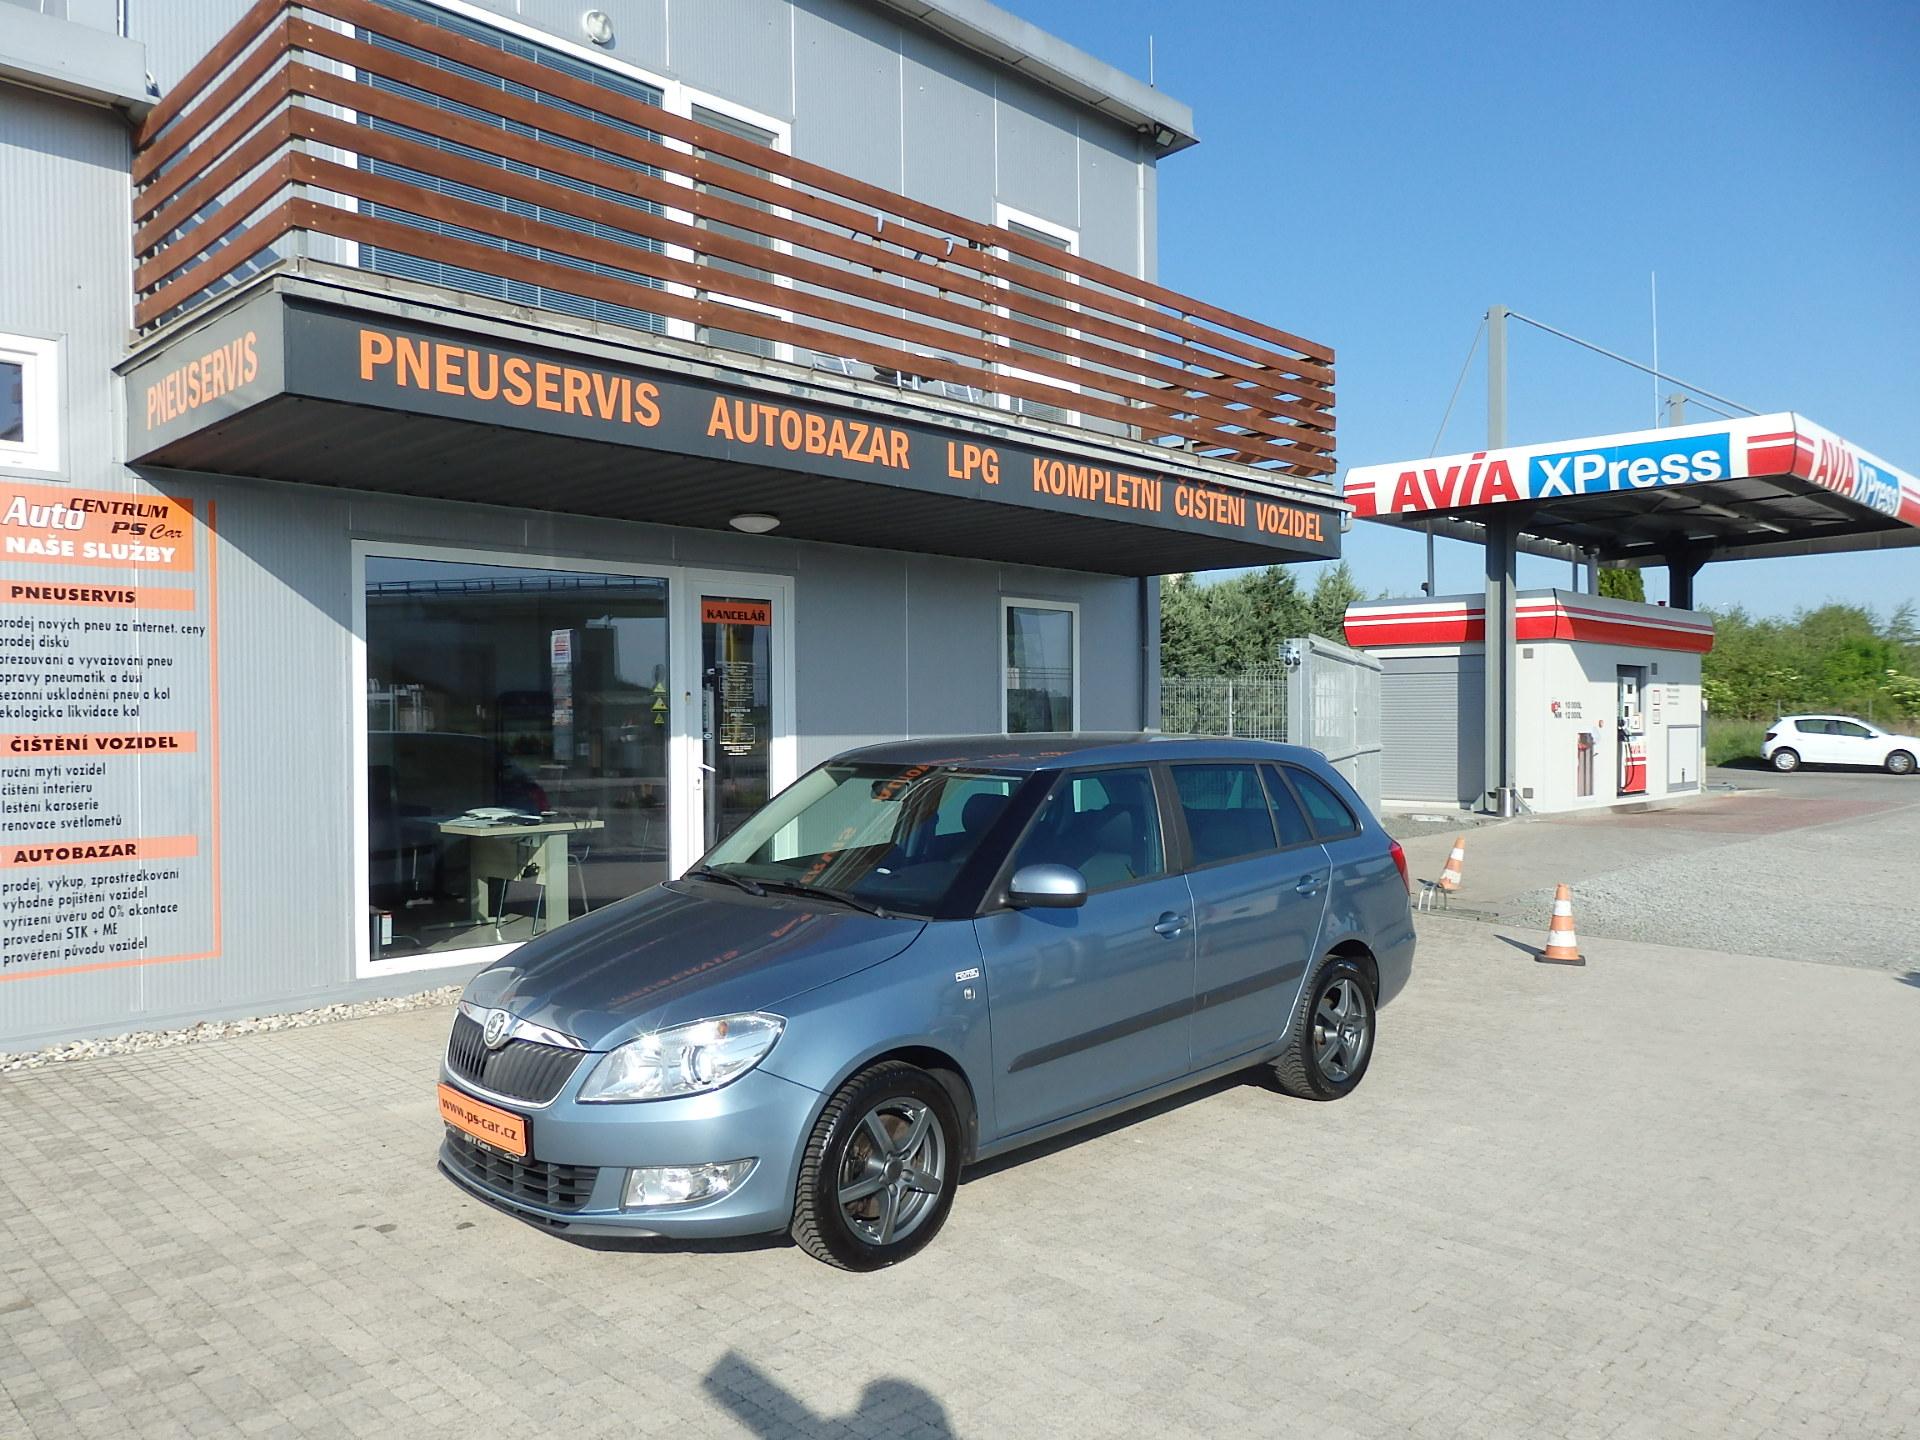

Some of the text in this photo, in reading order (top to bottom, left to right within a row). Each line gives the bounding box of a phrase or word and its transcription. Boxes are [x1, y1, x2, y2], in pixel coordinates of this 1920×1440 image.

[146, 331, 258, 431] PNEUSERVIS
[358, 328, 1325, 543] PNEUSERVIS AUTOBAZAR LPG KOMPLETNÍ ČIŠTĚNÍ VOZIDEL
[1538, 447, 1723, 499] XPress
[0, 496, 169, 531] Auto CENTRUM
[111, 520, 184, 540] PS Car
[5, 533, 177, 564] NAŠE SLUŽBY
[11, 585, 137, 604] PNEUSERVIS
[706, 607, 766, 623] KANCELÁŘ
[38, 617, 80, 633] nových
[84, 621, 111, 633] pneu
[115, 623, 128, 632] za
[181, 625, 206, 638] ceny
[67, 656, 74, 665] a
[147, 657, 173, 669] pneu
[44, 669, 106, 686] pneumatik
[110, 674, 117, 683] a
[113, 690, 139, 703] pneu
[143, 691, 150, 700] a
[154, 687, 171, 700] kol
[67, 703, 119, 718] likvidace
[123, 703, 140, 718] kol
[10, 733, 179, 752] ČIŠTĚNÍ VOZIDEL
[65, 761, 107, 776] vozidel
[45, 798, 99, 812] karoserie
[1, 819, 57, 832] renovace
[13, 843, 137, 864] AUTOBAZAR
[109, 885, 148, 901] vozidel
[91, 906, 105, 920] od
[108, 904, 125, 919] 0%
[128, 903, 179, 917] akontace
[66, 924, 89, 940] STK
[102, 921, 119, 936] ME
[109, 935, 148, 952] vozidel
[442, 1098, 518, 1141] www.ps-car.cz
